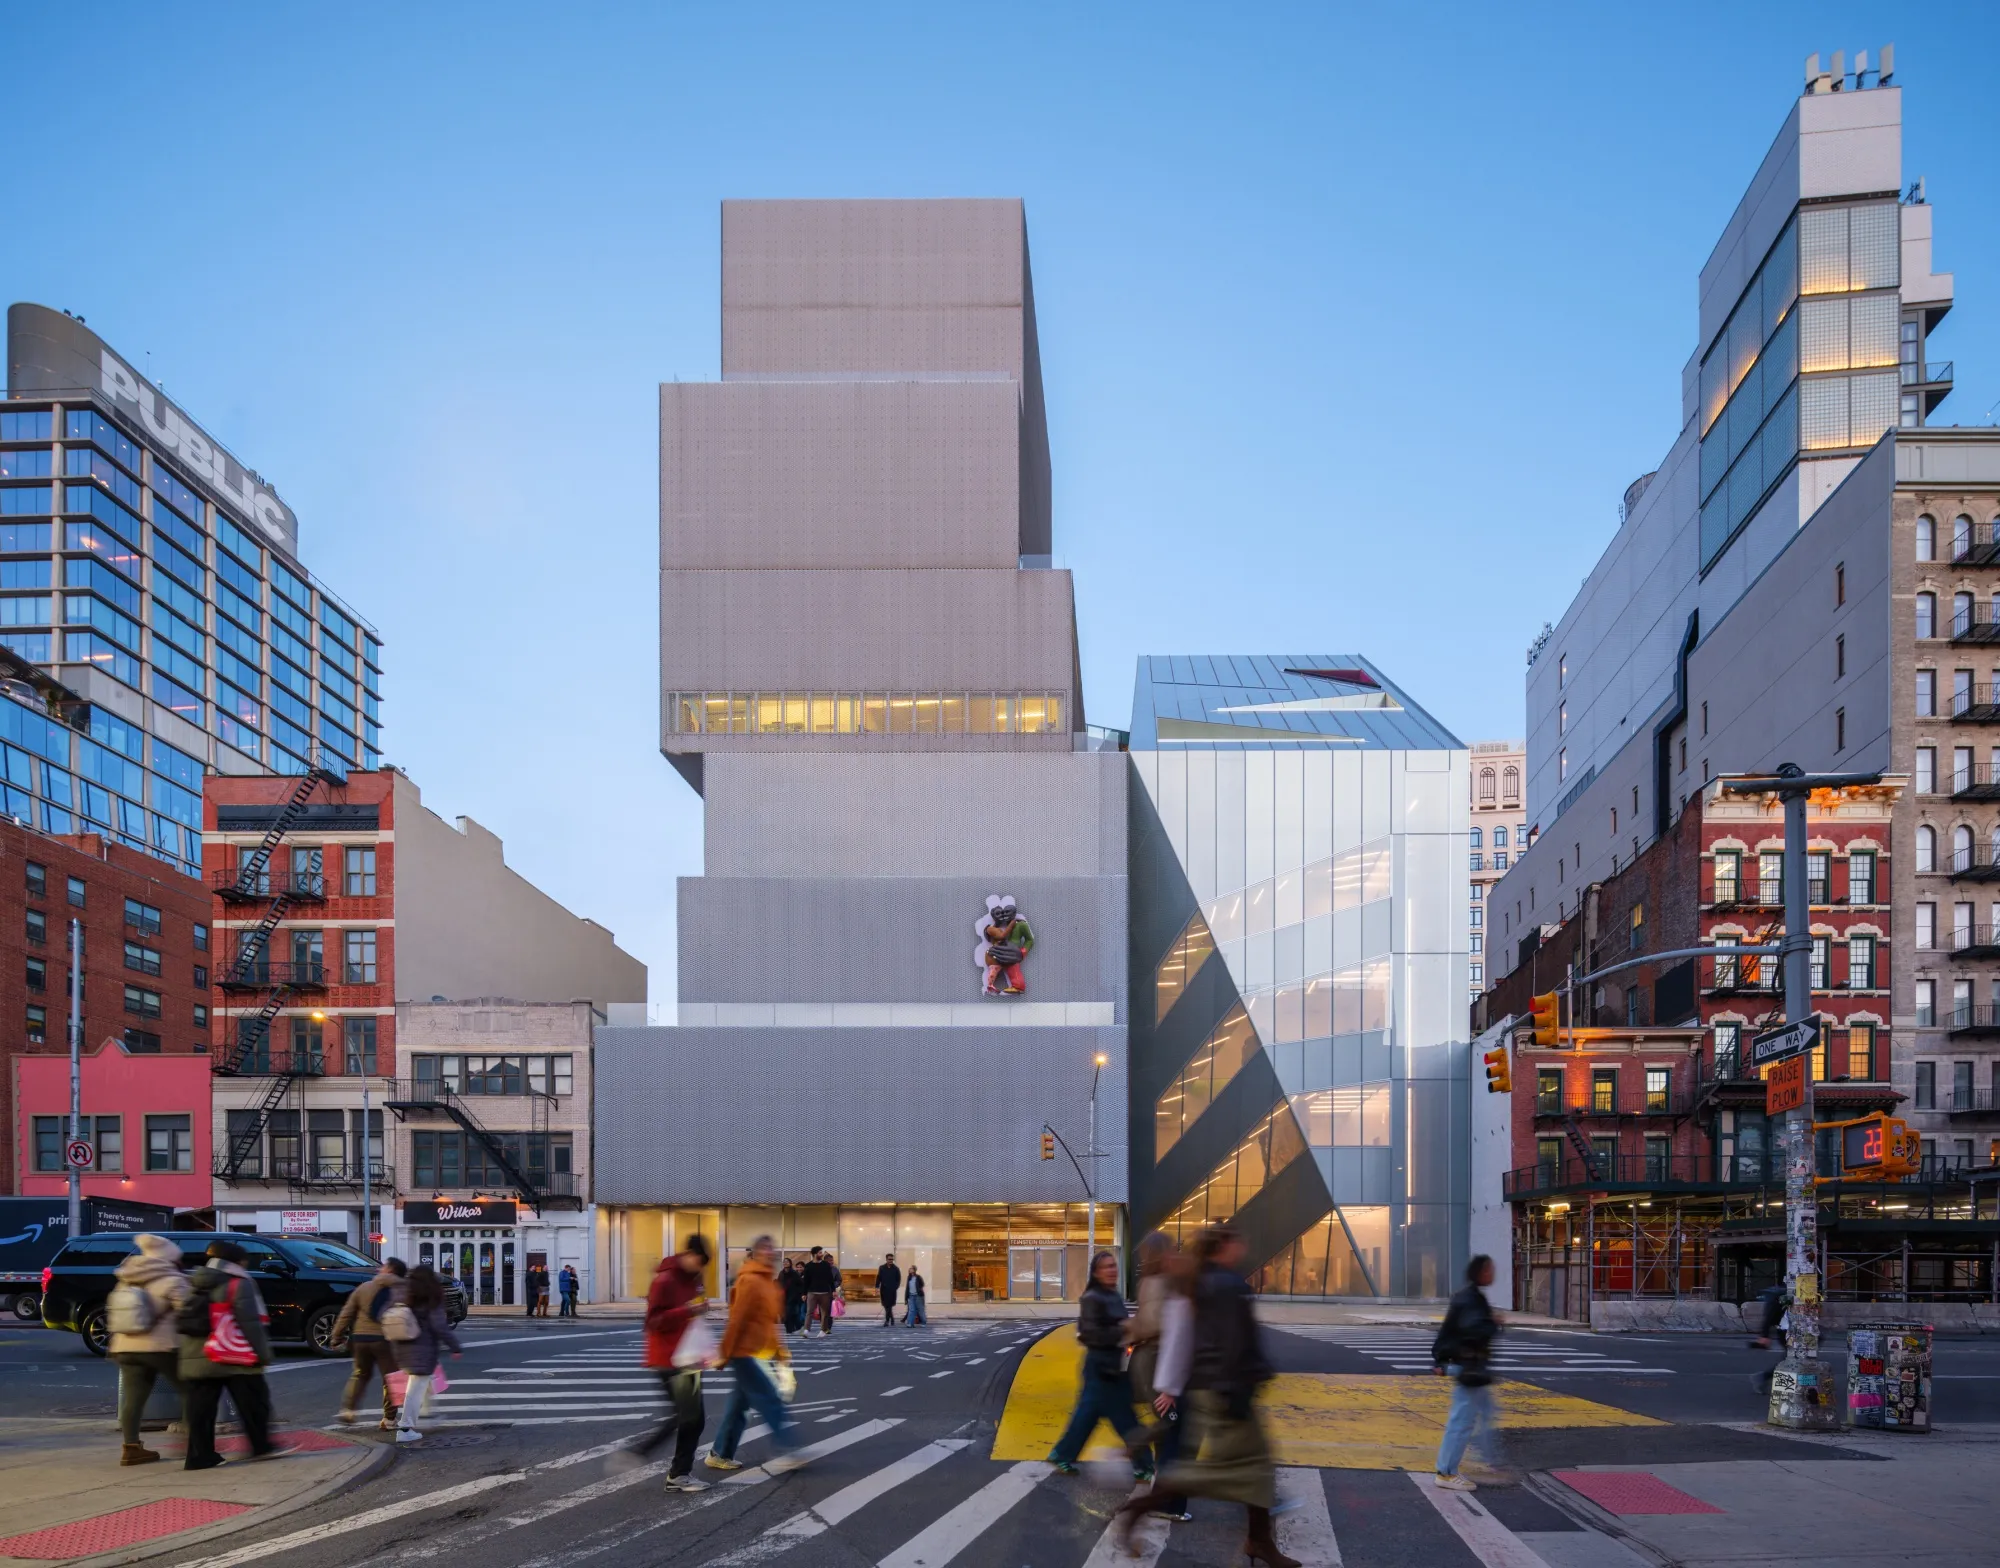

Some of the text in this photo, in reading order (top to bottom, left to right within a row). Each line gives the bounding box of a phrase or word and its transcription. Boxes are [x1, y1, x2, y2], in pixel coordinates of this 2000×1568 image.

[100, 349, 286, 541] PUBLIC
[1758, 1029, 1806, 1056] ONE WAY
[1772, 1063, 1799, 1086] RAISE
[1772, 1087, 1798, 1109] PLOW
[97, 1211, 125, 1220] There's
[437, 1204, 482, 1220] Wilka's
[108, 1220, 131, 1229] Prime.
